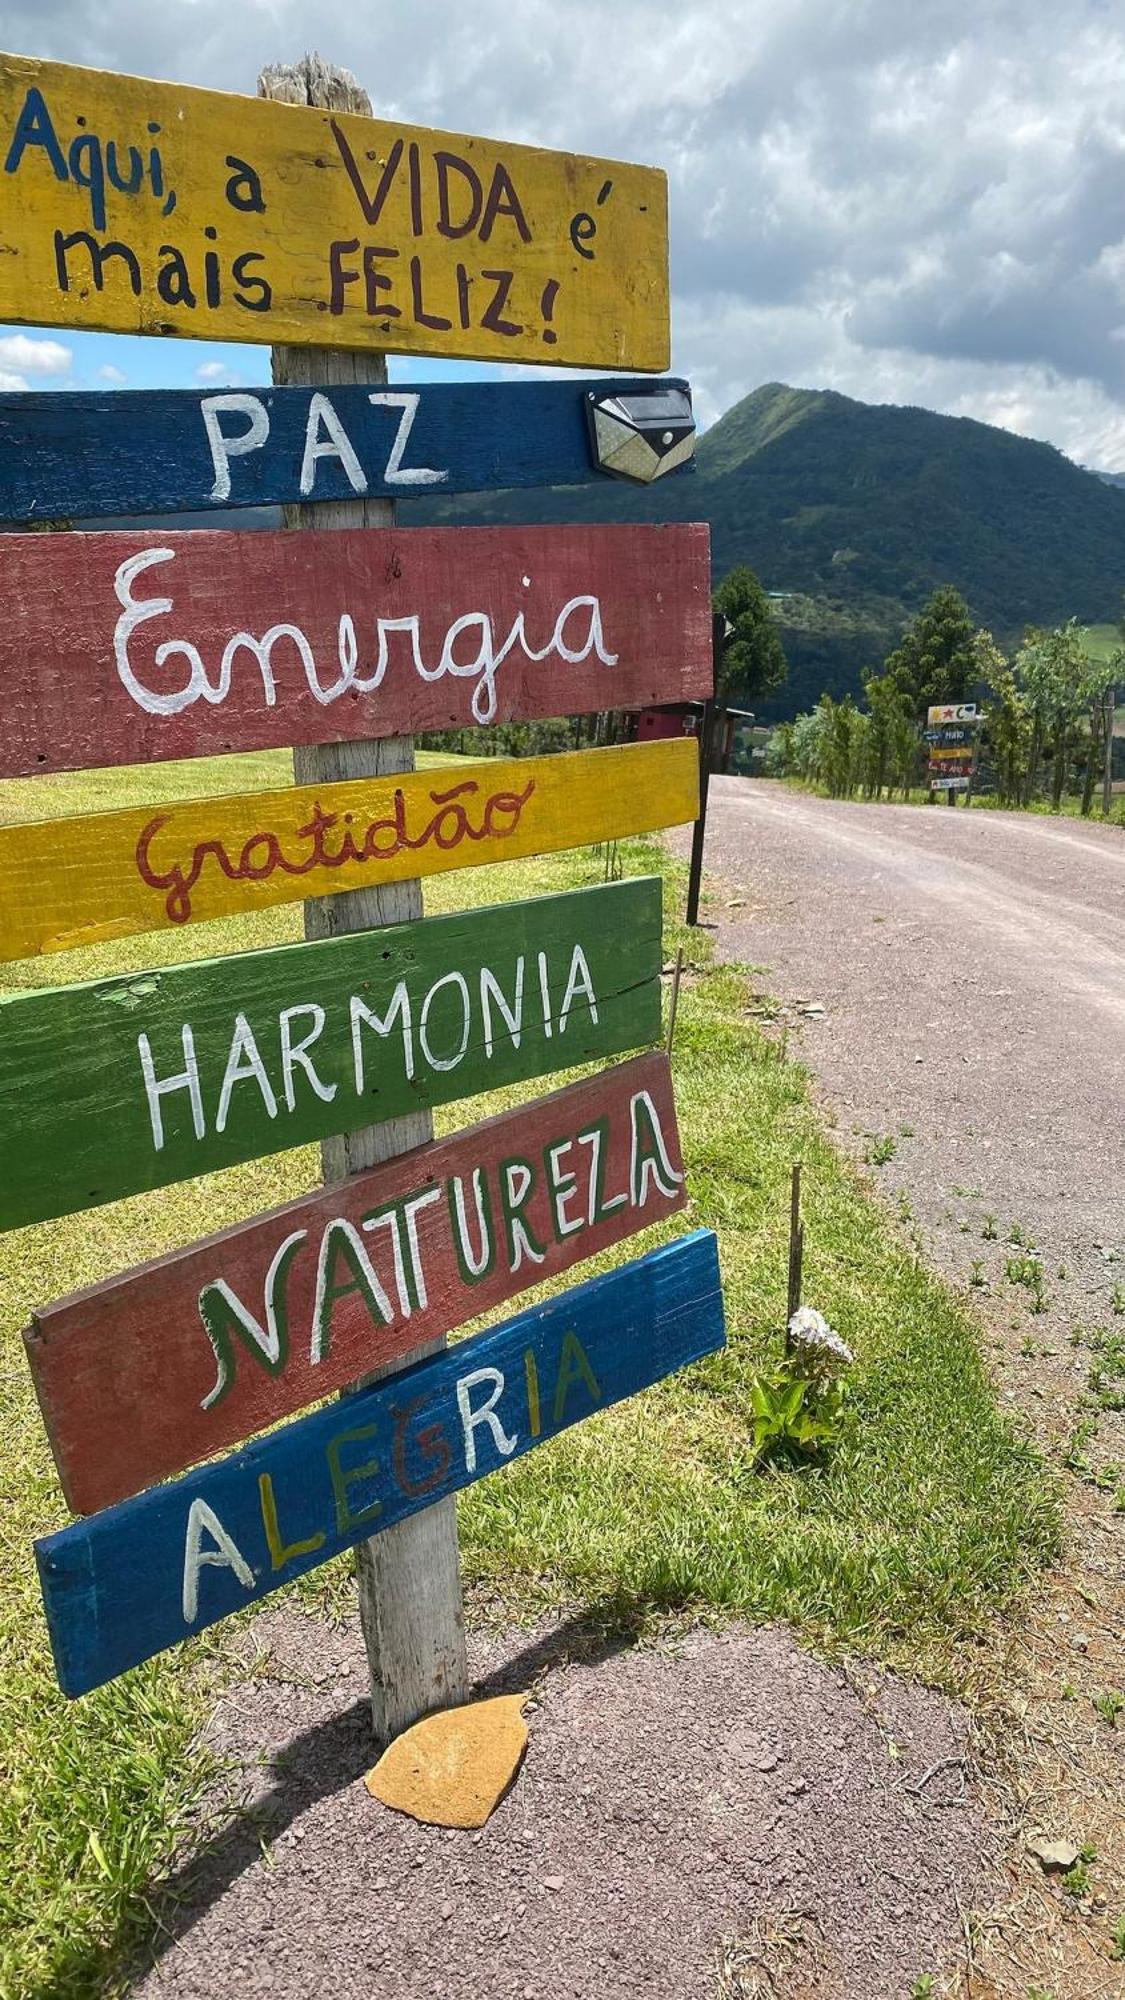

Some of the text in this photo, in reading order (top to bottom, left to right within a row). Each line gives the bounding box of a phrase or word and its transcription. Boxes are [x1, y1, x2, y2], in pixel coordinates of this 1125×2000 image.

[4, 87, 613, 259] Aqui, a VIDA é
[54, 225, 561, 344] mais FELIZ!
[200, 391, 449, 501] PAZ
[113, 547, 618, 725] Energia
[136, 779, 536, 923] Gratidão
[138, 944, 599, 1151] HARMONIA
[198, 1089, 684, 1410] NATUREZA
[182, 1331, 601, 1624] ALEGRIA
